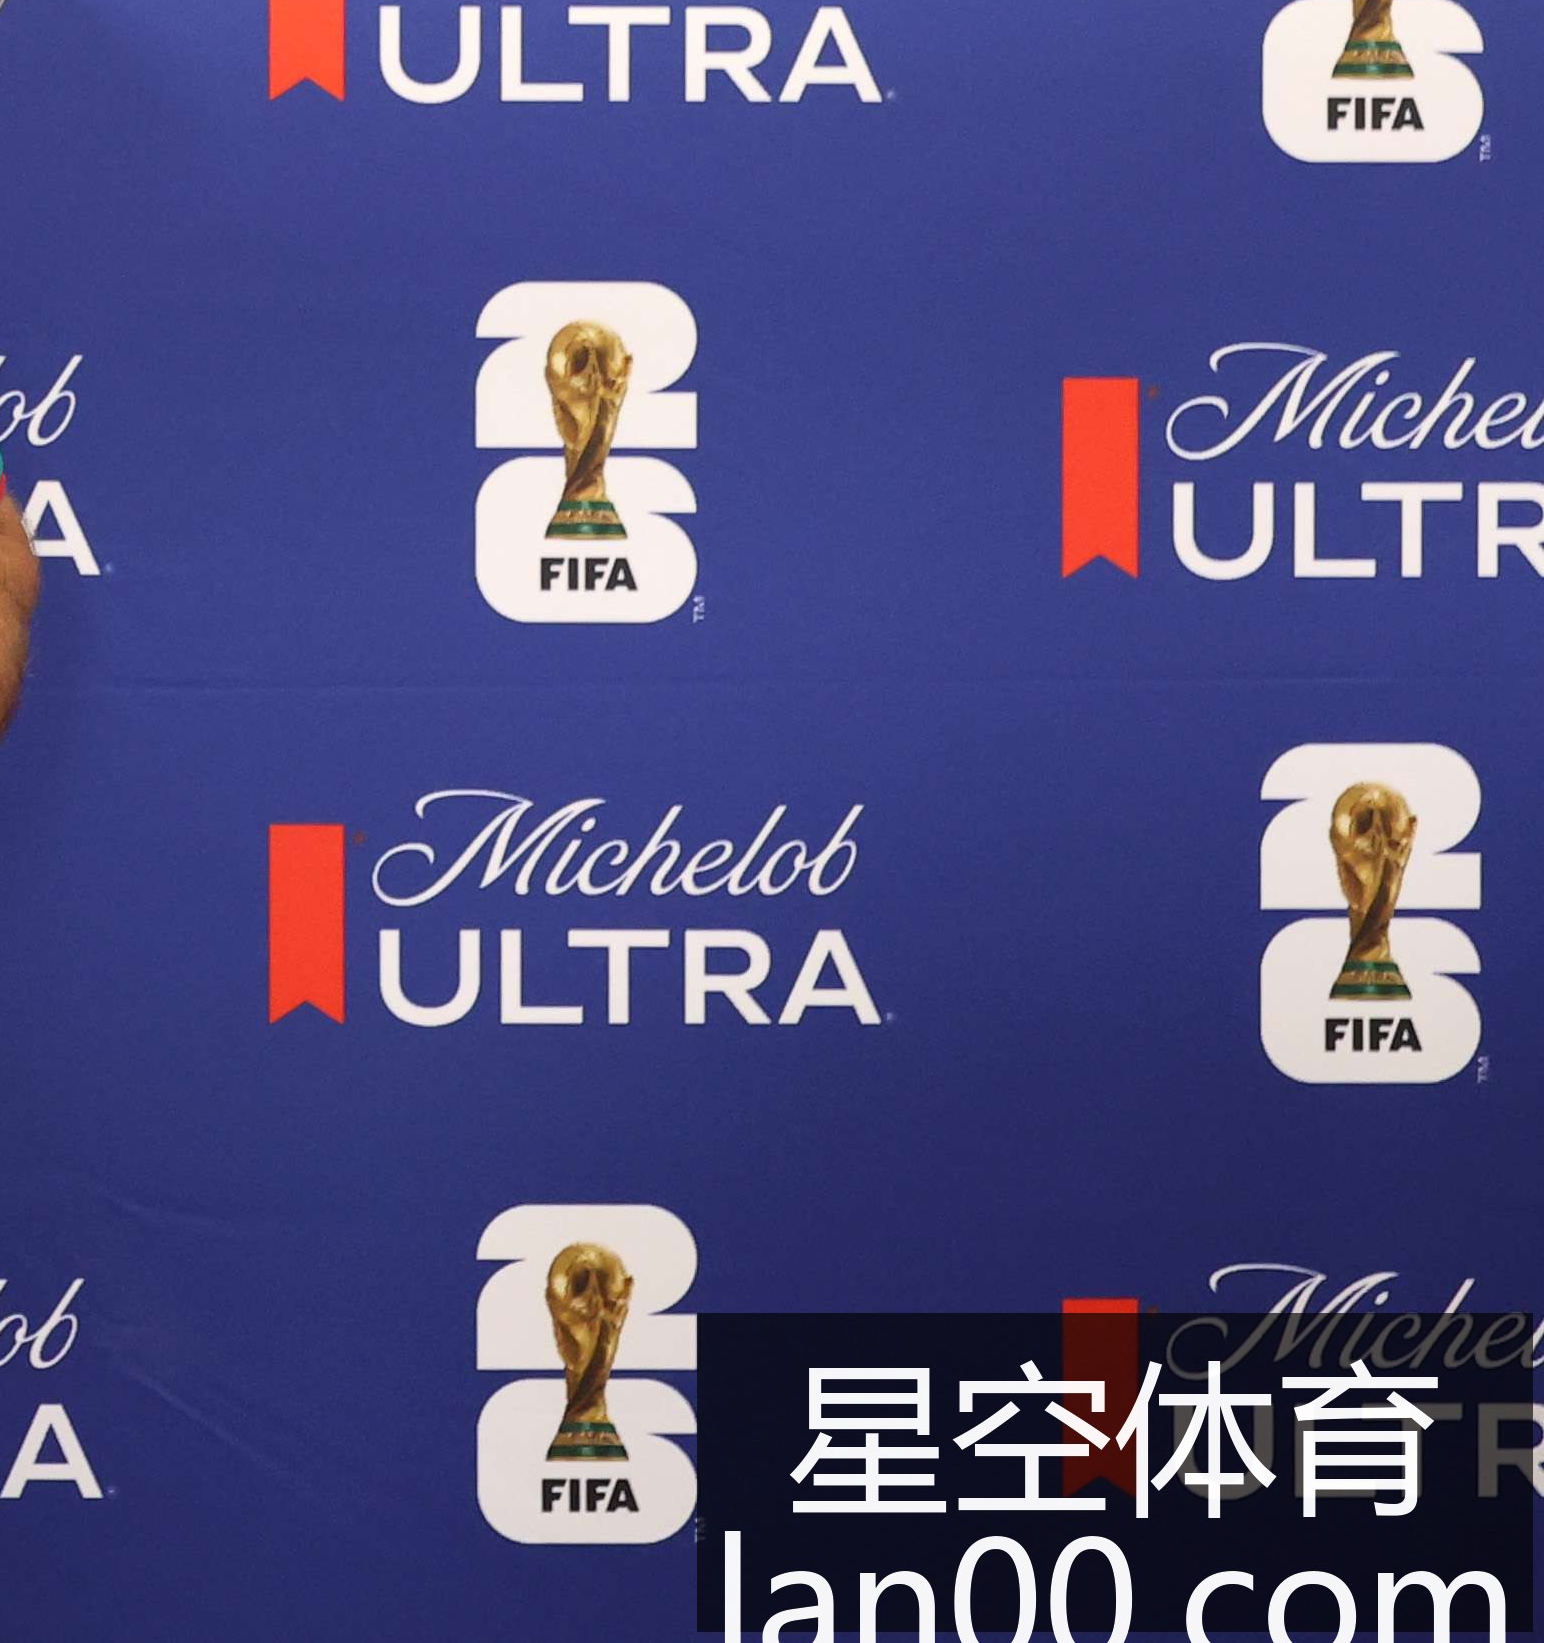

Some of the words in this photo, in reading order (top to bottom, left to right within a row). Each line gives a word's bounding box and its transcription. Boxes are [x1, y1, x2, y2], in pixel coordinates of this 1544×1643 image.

[378, 4, 883, 105] ULTRA
[1326, 97, 1425, 131] FIFA
[539, 558, 638, 592] FIFA
[371, 788, 865, 908] Michelob
[378, 927, 883, 1028] ULTRA
[1323, 1019, 1423, 1053] FIFA
[540, 1479, 641, 1514] FIFA
